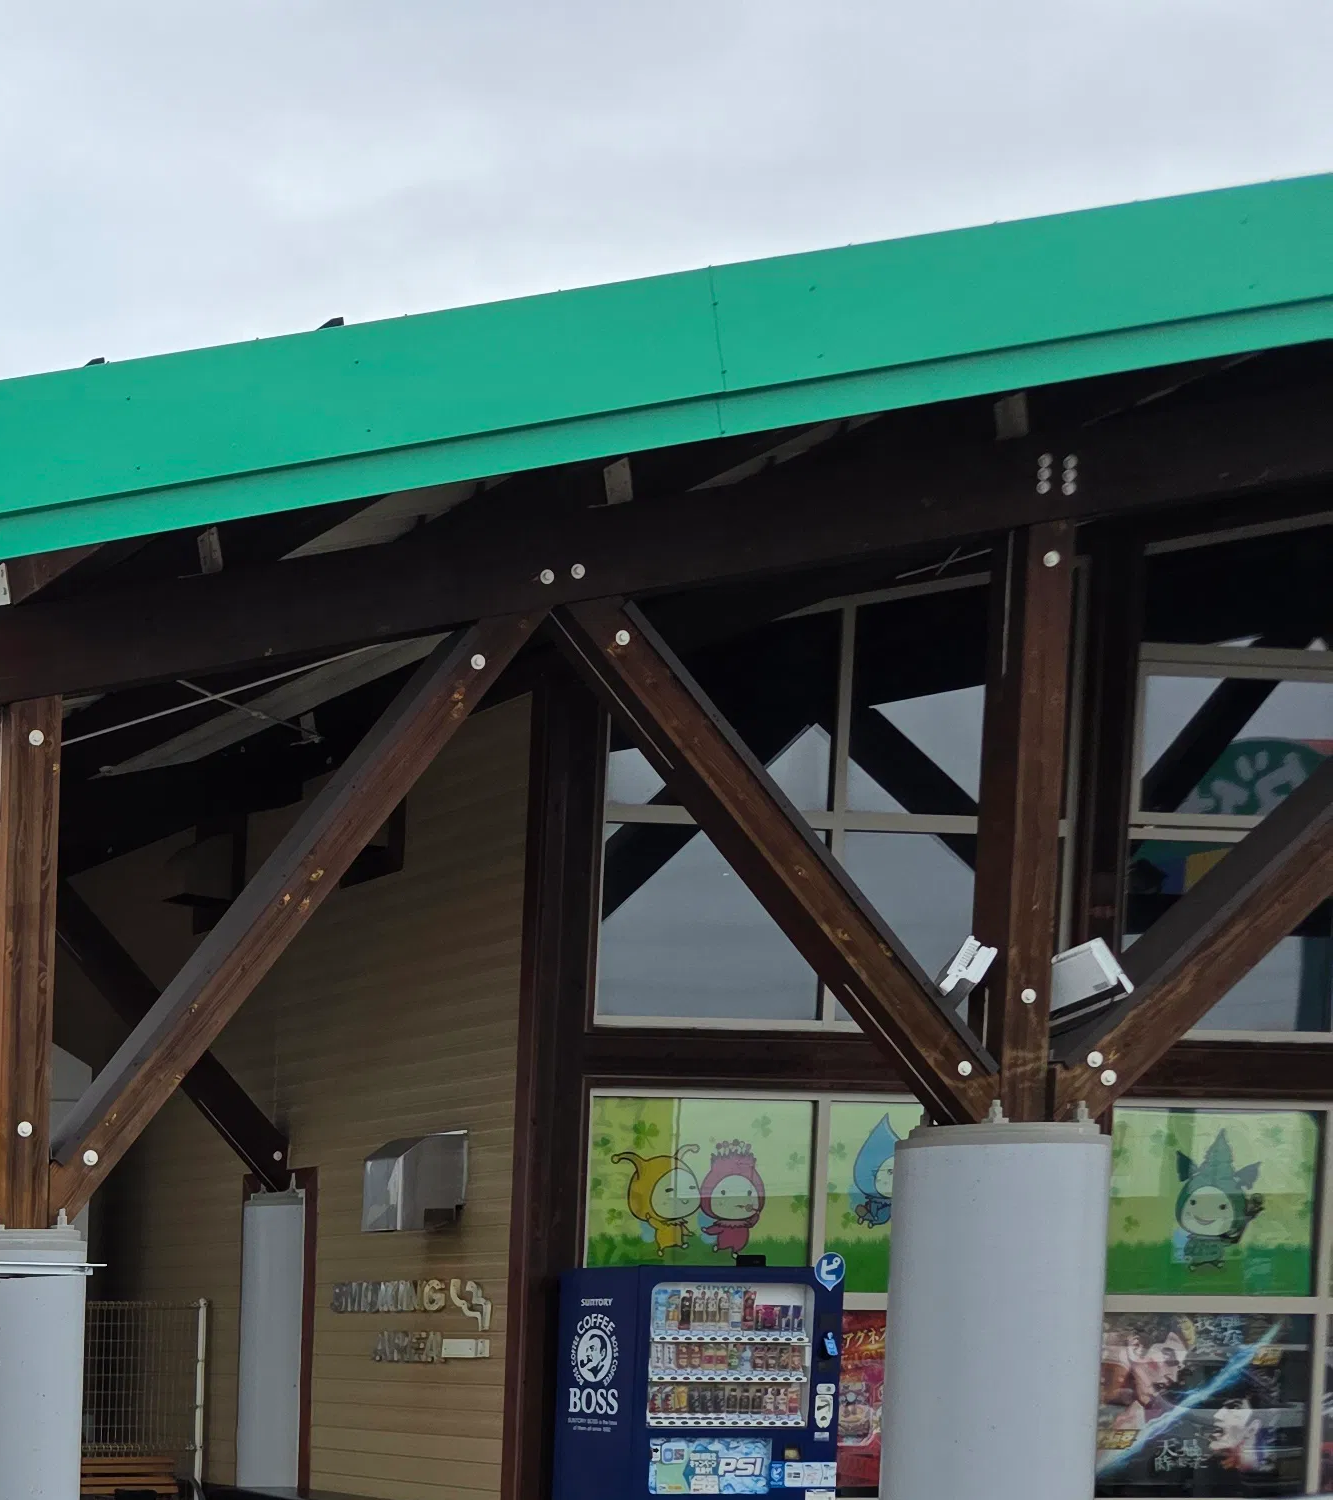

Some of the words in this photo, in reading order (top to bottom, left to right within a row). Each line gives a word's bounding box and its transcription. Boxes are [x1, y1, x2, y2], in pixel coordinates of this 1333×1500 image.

[330, 1279, 446, 1312] SMOKING
[580, 1298, 613, 1307] SUNTORY
[577, 1313, 615, 1336] COFFEE
[372, 1330, 444, 1363] AREA
[568, 1388, 619, 1415] BOSS
